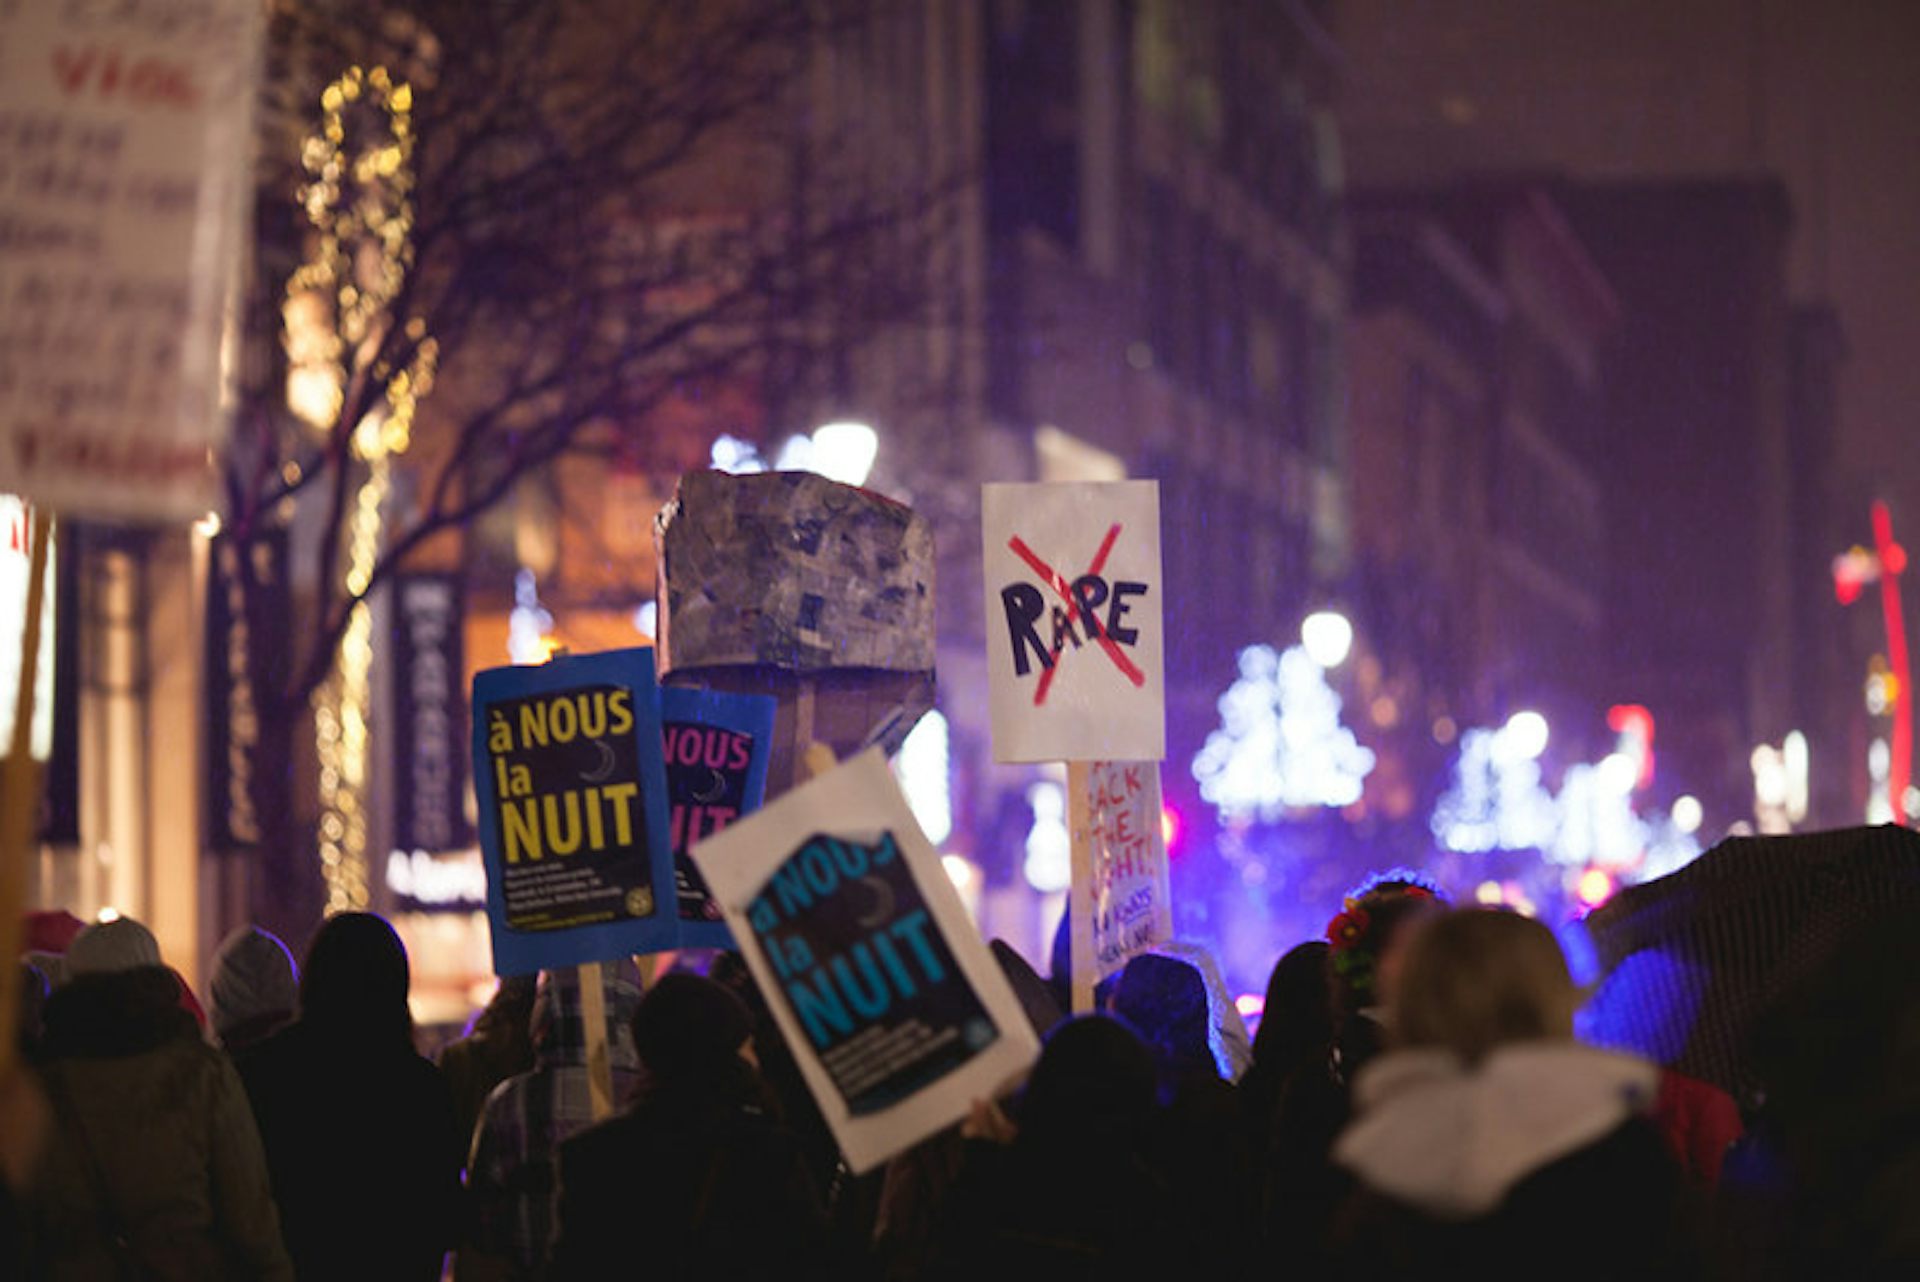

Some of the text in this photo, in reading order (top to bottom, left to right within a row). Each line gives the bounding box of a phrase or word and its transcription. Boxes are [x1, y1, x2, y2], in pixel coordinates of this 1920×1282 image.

[1001, 573, 1149, 678] RAPE
[489, 690, 634, 753] à NOUS
[495, 757, 532, 799] la
[502, 782, 638, 863] NUIT
[763, 932, 813, 980] la
[788, 908, 945, 1048] NUIT
